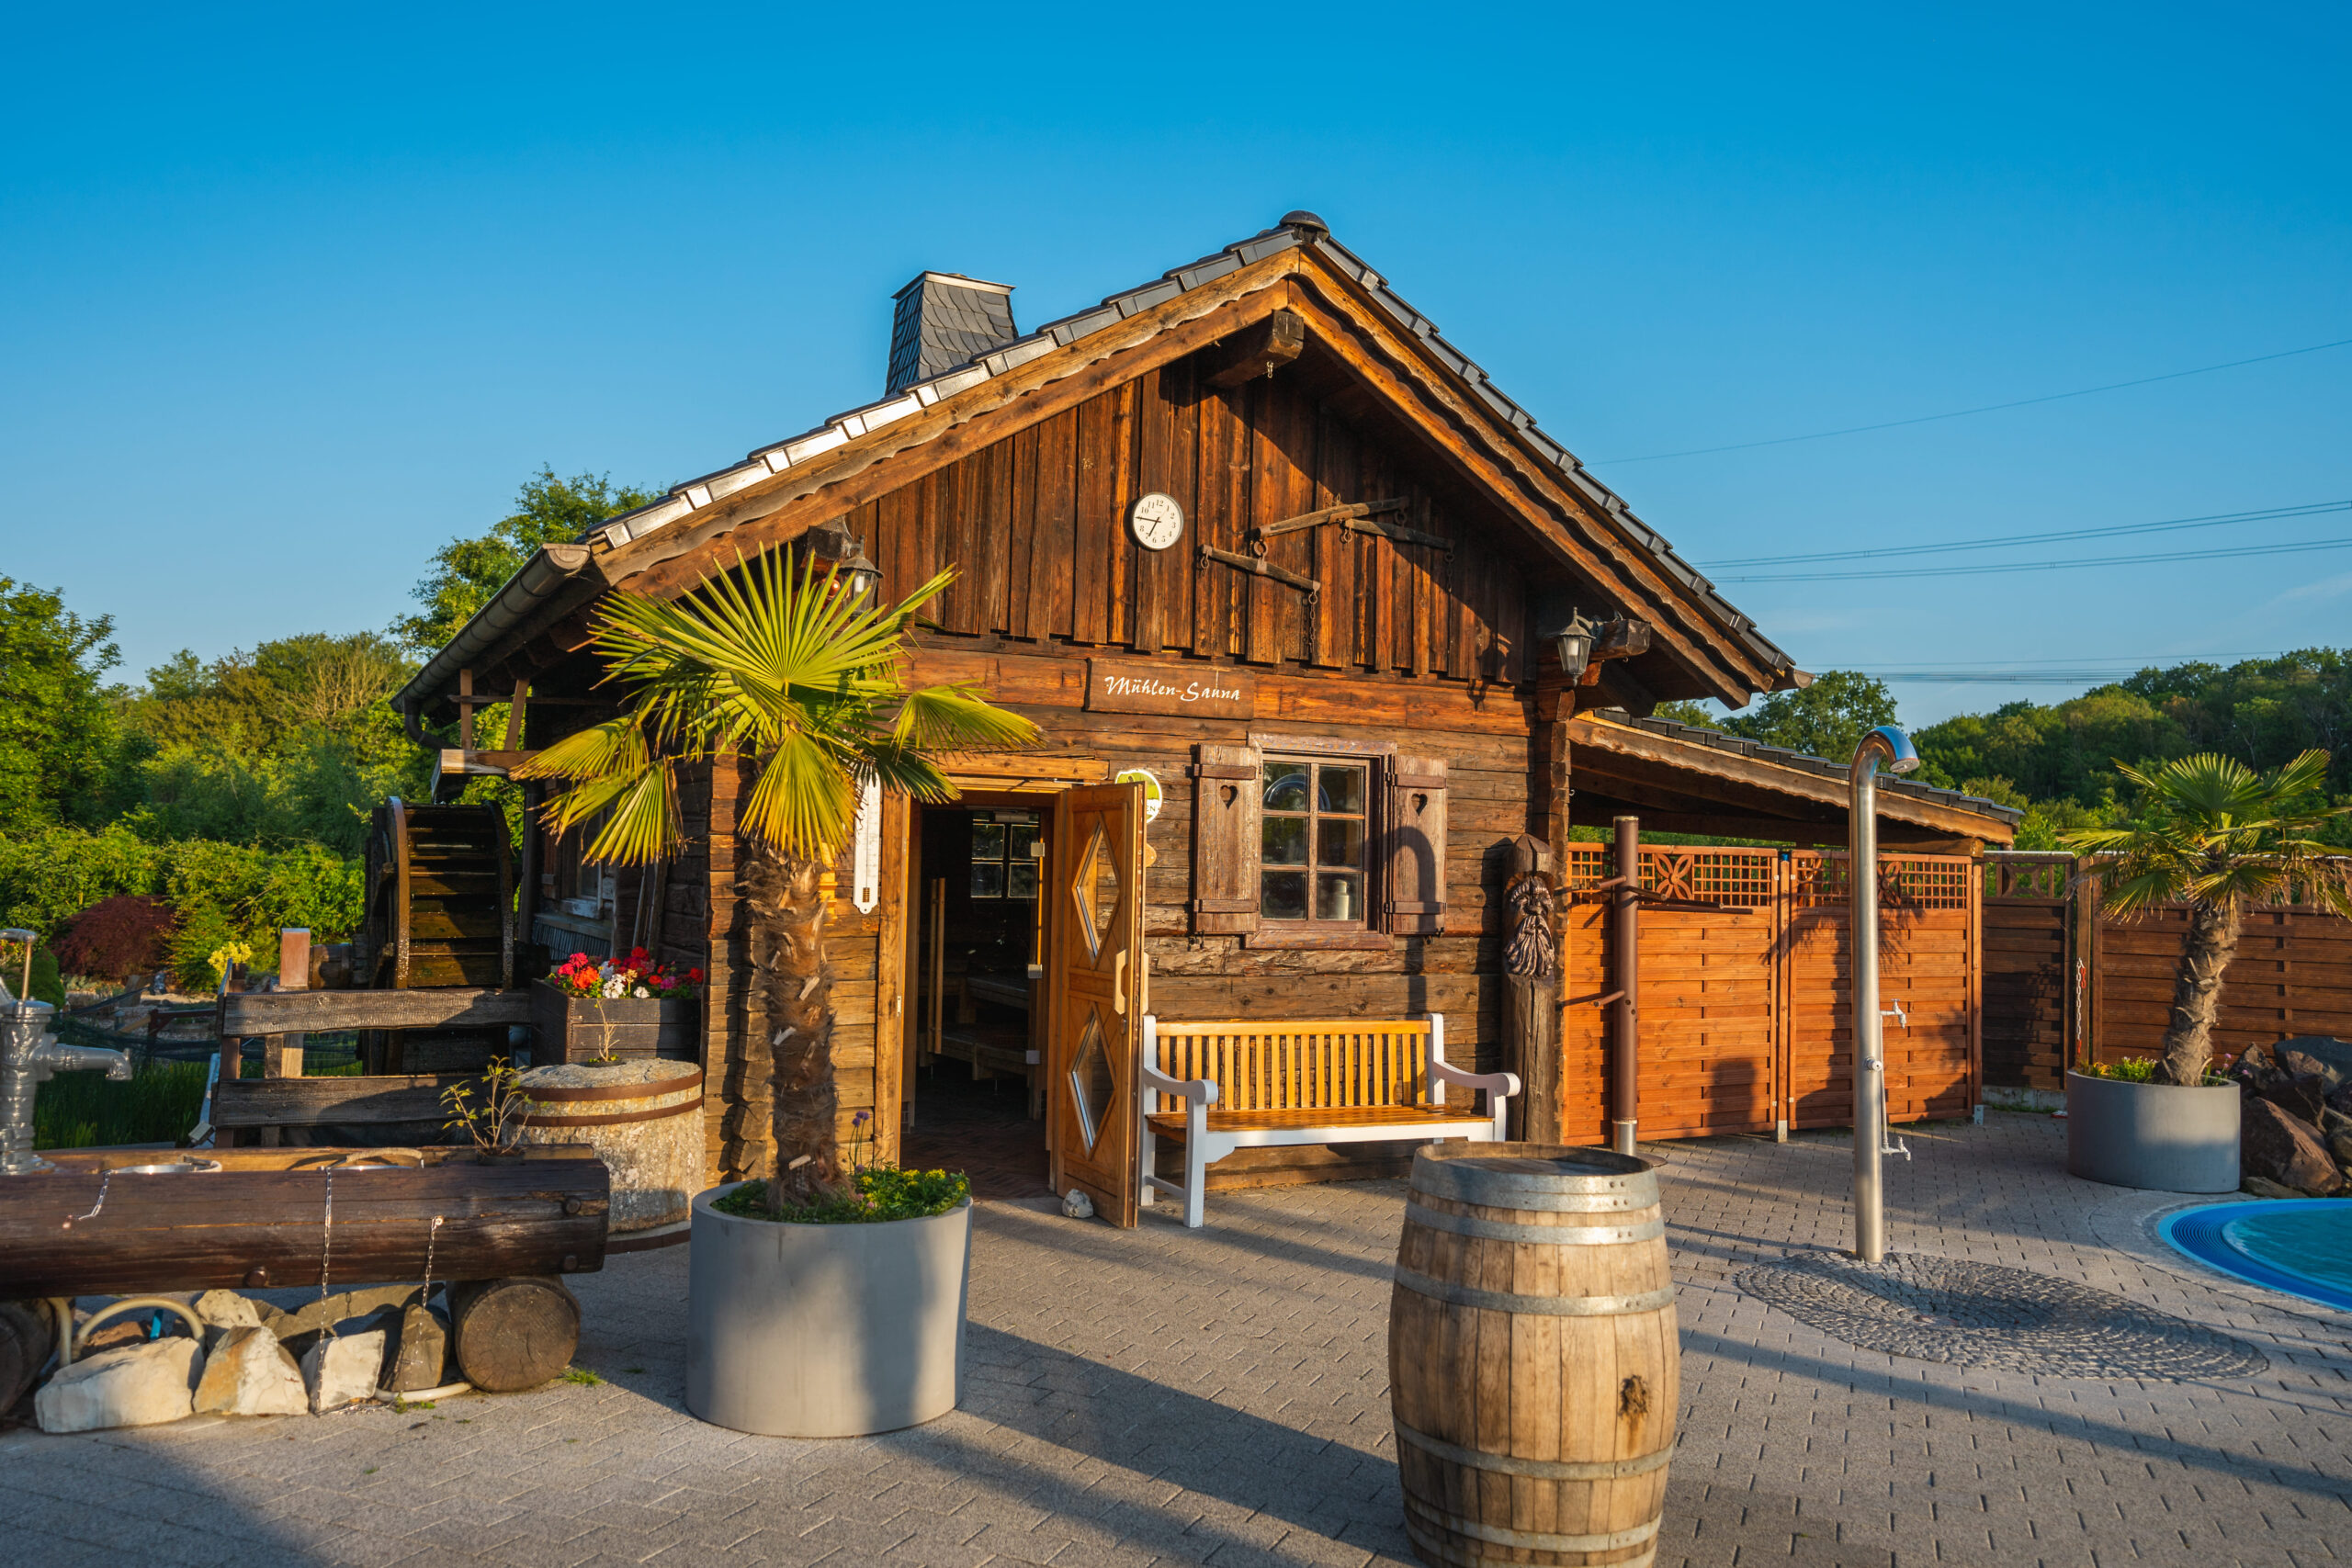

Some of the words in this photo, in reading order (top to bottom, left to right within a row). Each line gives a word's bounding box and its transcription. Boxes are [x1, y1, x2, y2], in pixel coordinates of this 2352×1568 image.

[1148, 501, 1155, 509] 11
[1157, 499, 1164, 507] 12
[1139, 525, 1145, 533] 8
[1103, 676, 1240, 702] Mühlen-Sauna
